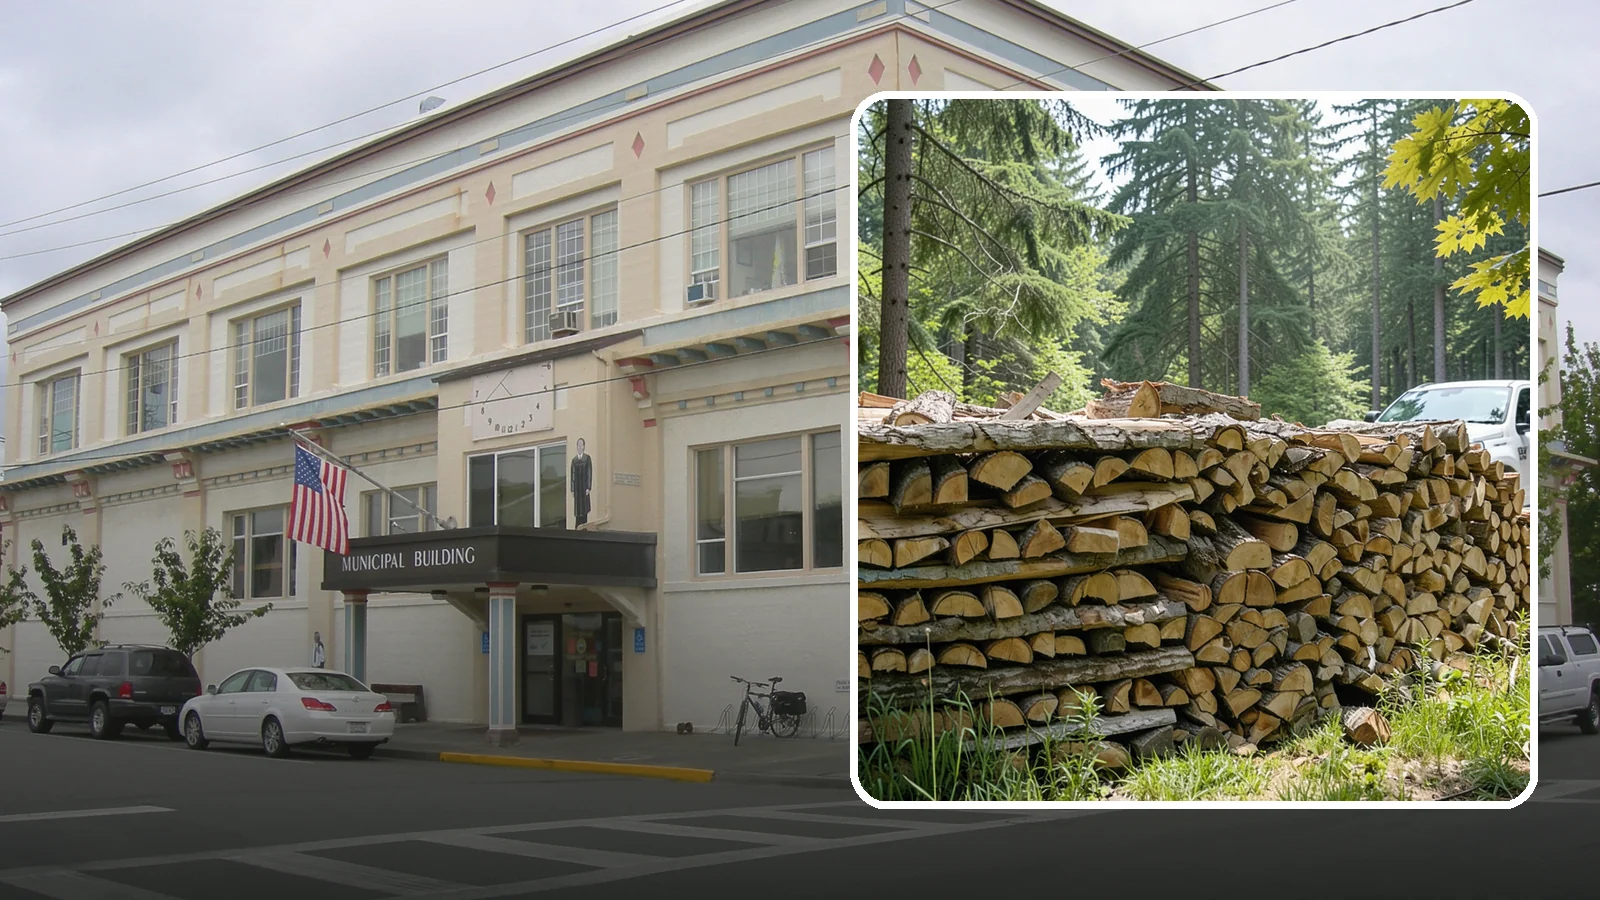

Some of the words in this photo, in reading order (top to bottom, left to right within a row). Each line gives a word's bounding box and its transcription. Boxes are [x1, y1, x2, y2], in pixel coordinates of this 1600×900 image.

[488, 418, 492, 426] 9
[529, 414, 533, 422] 3
[521, 420, 525, 428] 2
[501, 425, 506, 433] 11
[342, 552, 405, 572] MUNICIPAL
[414, 547, 475, 567] BUILDING
